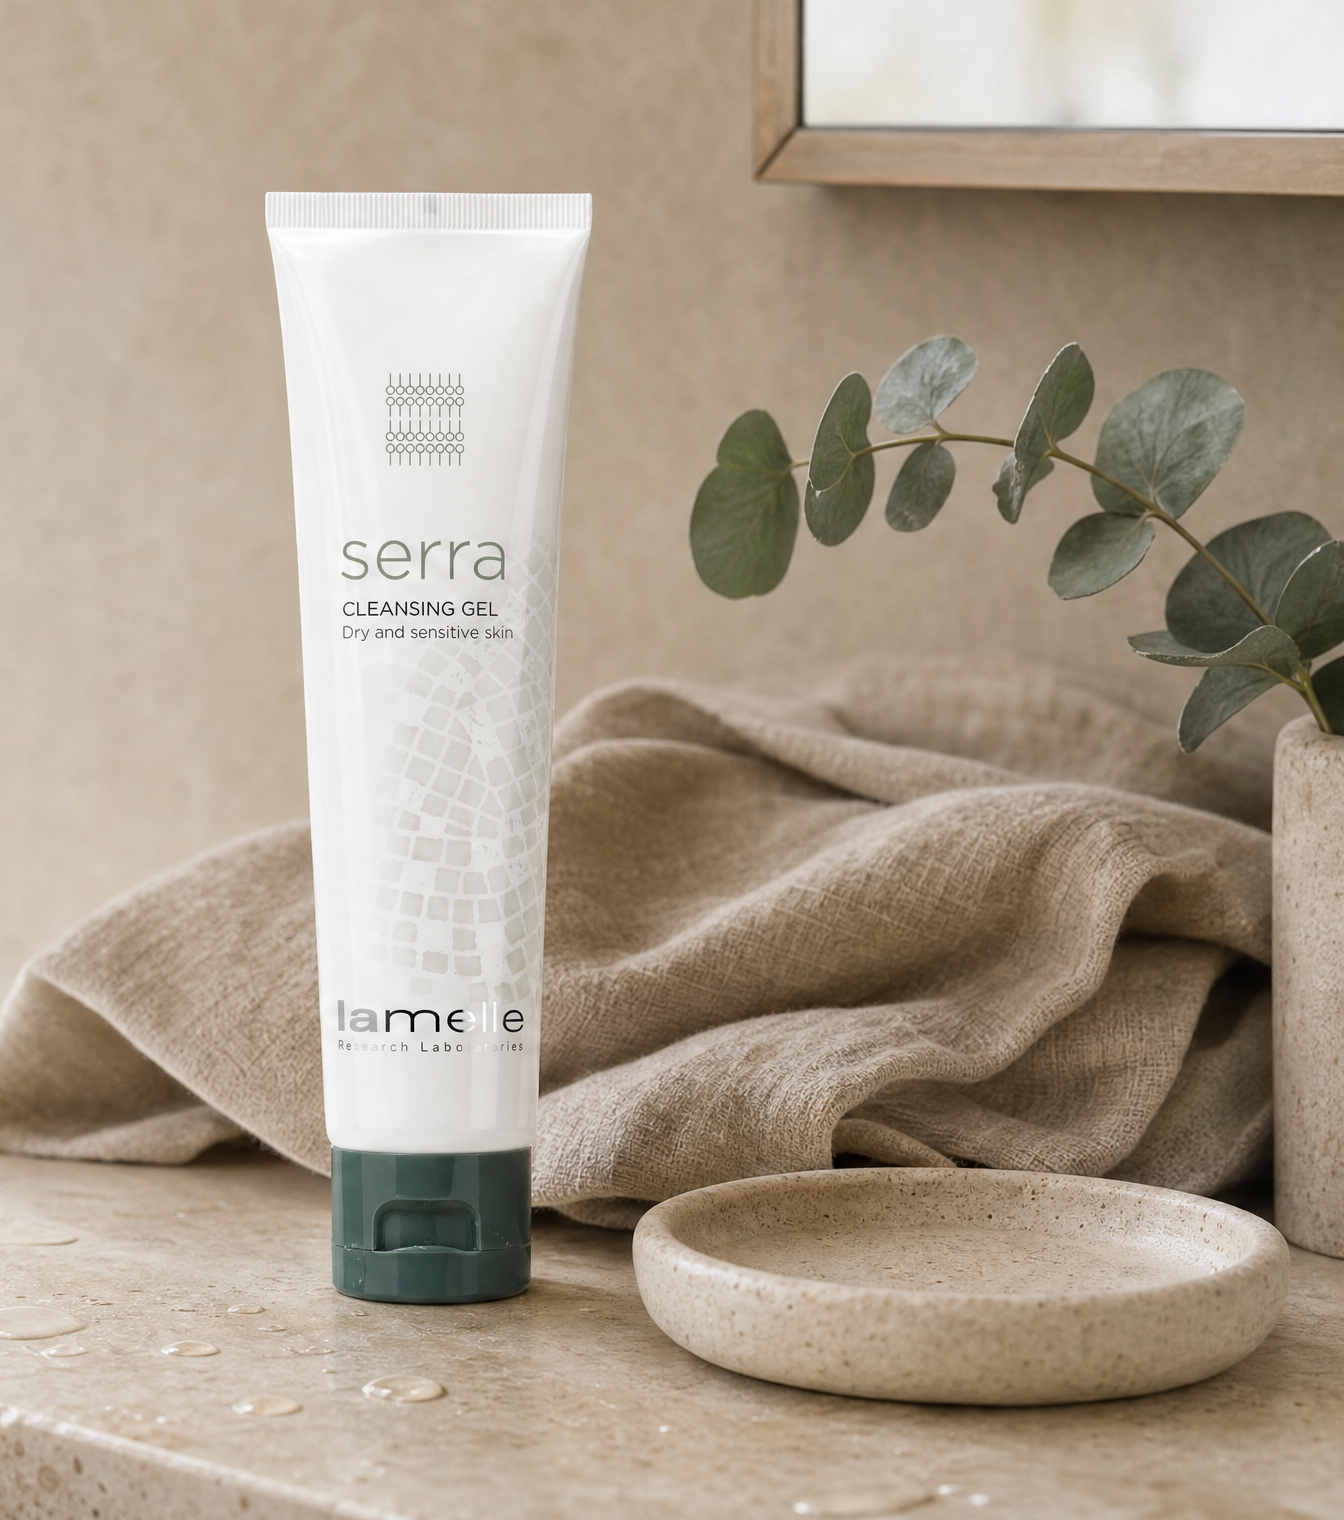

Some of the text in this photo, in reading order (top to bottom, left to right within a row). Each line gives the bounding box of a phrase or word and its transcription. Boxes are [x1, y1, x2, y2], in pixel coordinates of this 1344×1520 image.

[341, 540, 506, 581] serra
[343, 601, 499, 617] CLEANSING GEL
[342, 625, 514, 642] Dry and sensitive skin
[337, 999, 524, 1033] lamelle
[338, 1040, 409, 1052] Research
